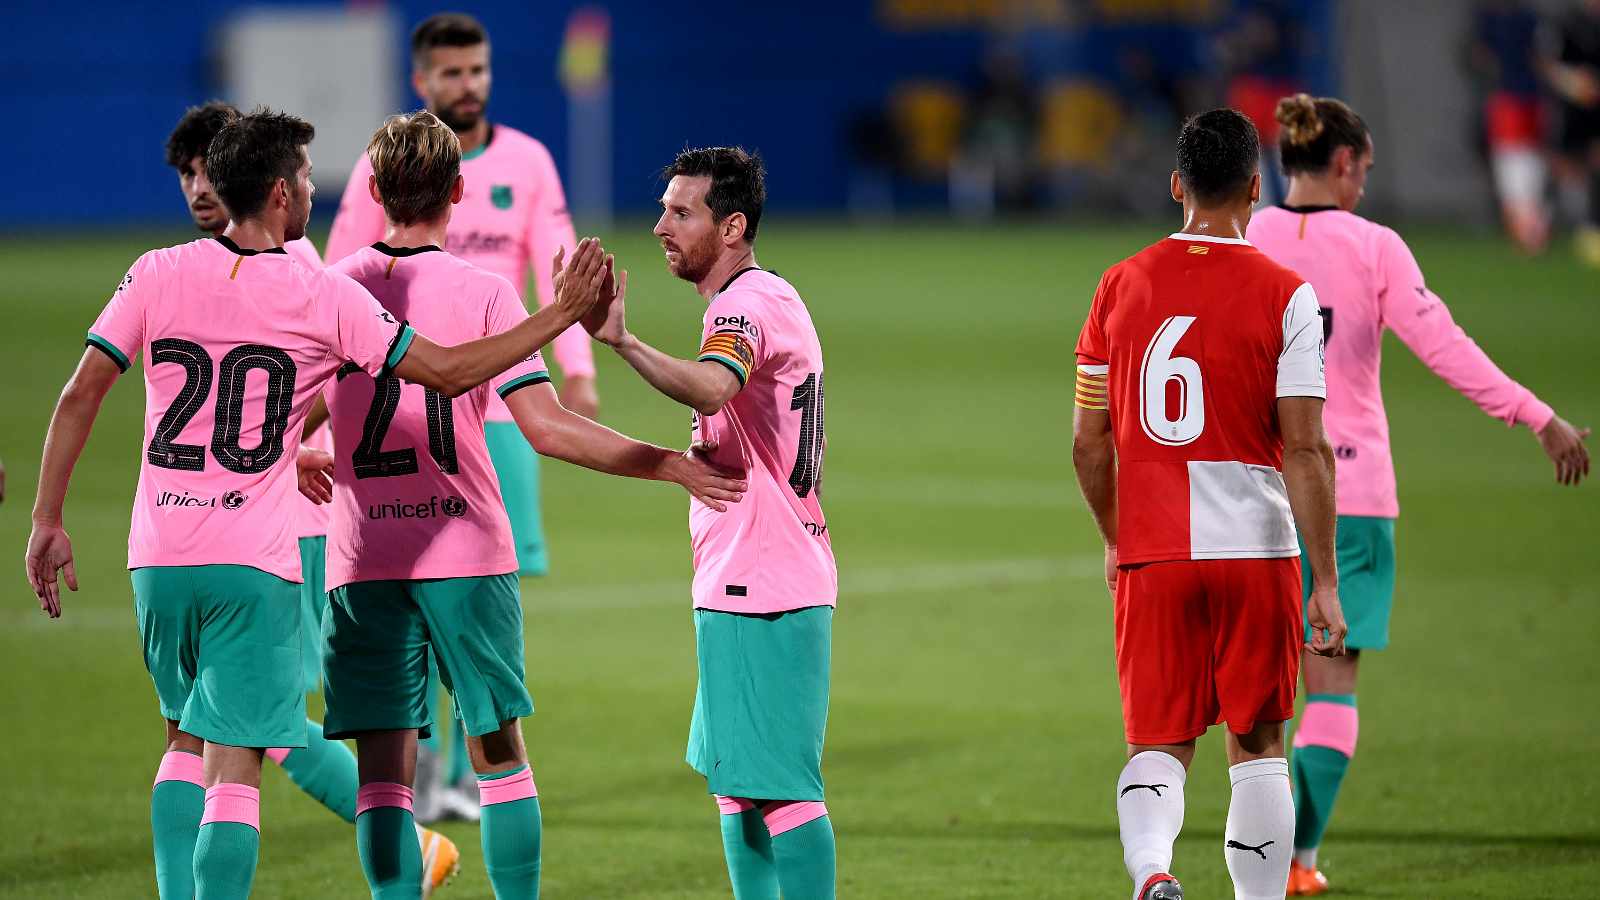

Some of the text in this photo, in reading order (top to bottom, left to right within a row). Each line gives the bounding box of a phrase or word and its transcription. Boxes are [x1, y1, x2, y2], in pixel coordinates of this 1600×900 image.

[148, 338, 297, 473] 20
[337, 361, 459, 479] 21
[1140, 316, 1205, 446] 6
[369, 496, 438, 519] unicef
